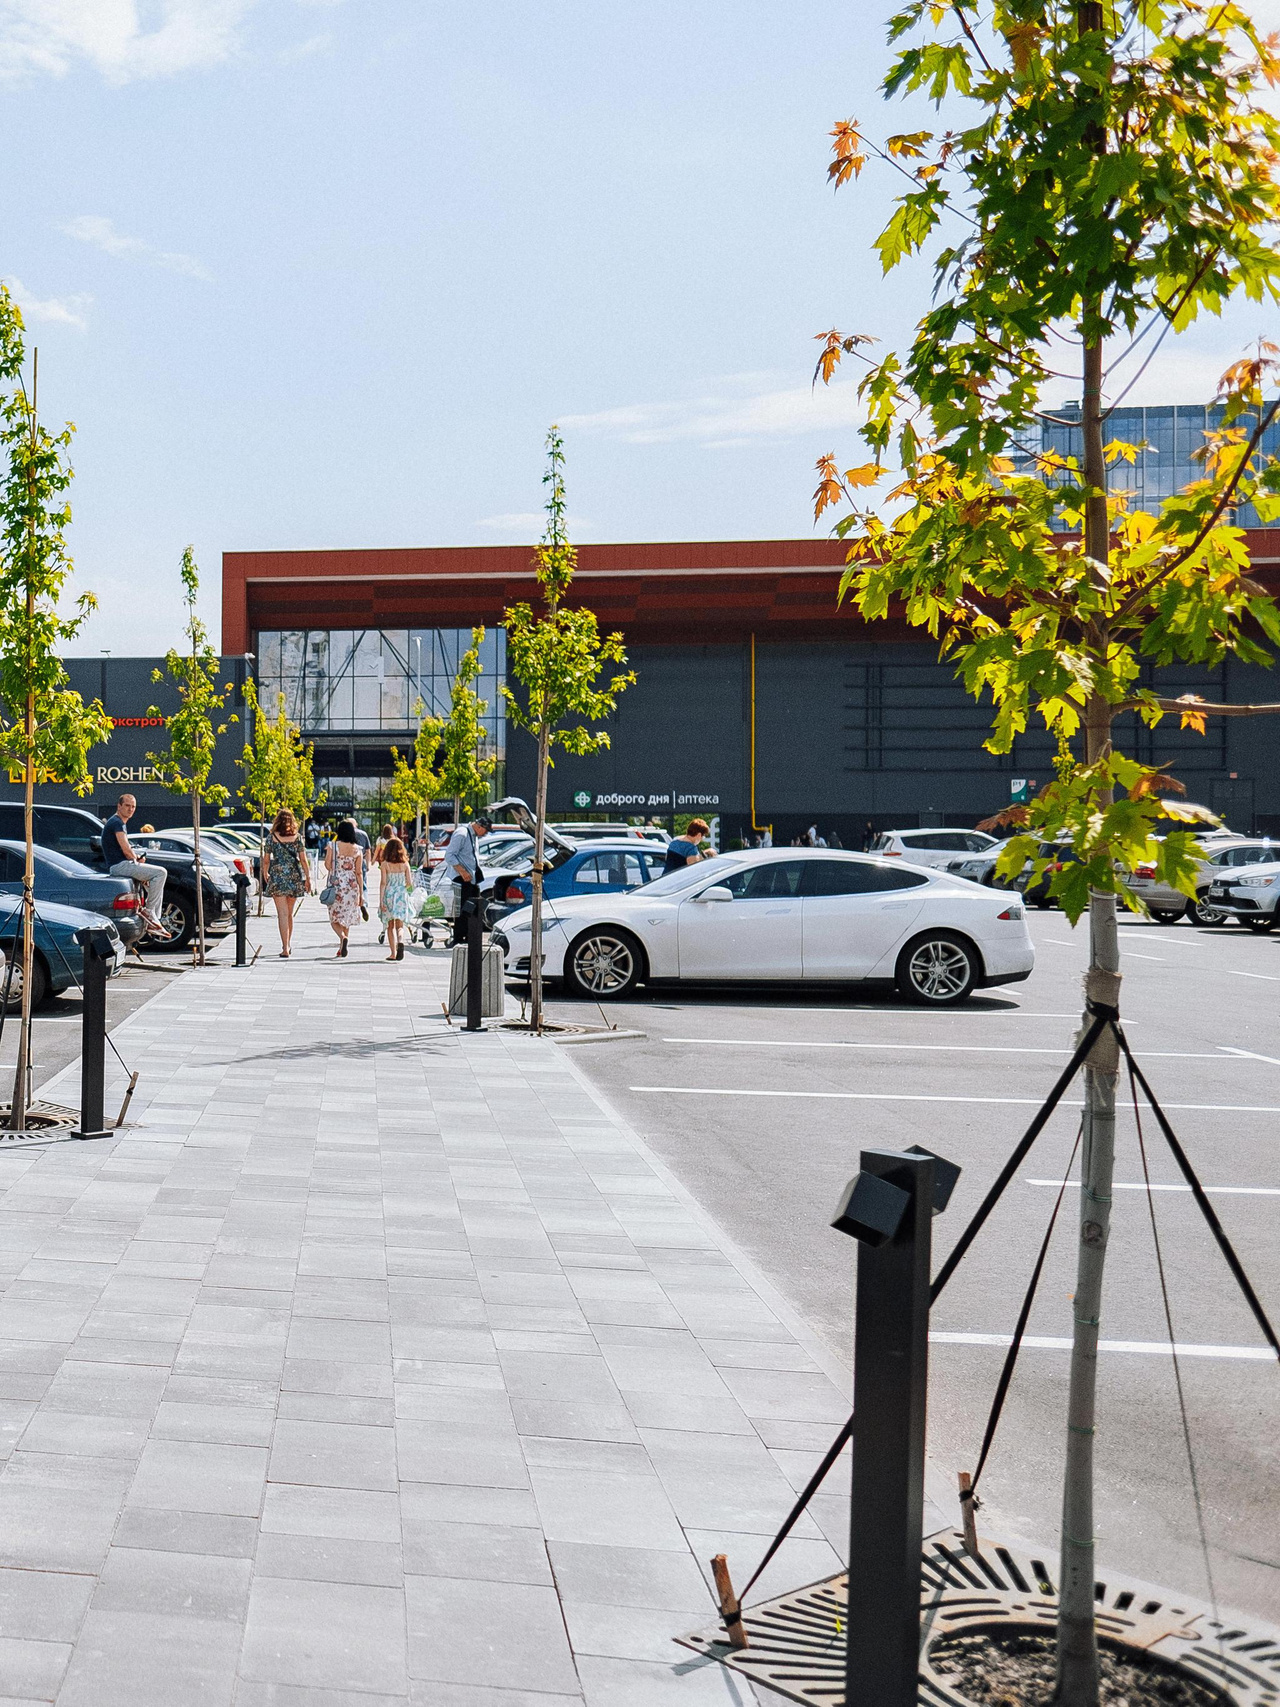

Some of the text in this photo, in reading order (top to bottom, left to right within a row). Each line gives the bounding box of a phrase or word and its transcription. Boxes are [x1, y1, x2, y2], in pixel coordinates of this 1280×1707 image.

[97, 766, 164, 783] ROSHEN
[596, 793, 719, 806] доброго дня аптека
